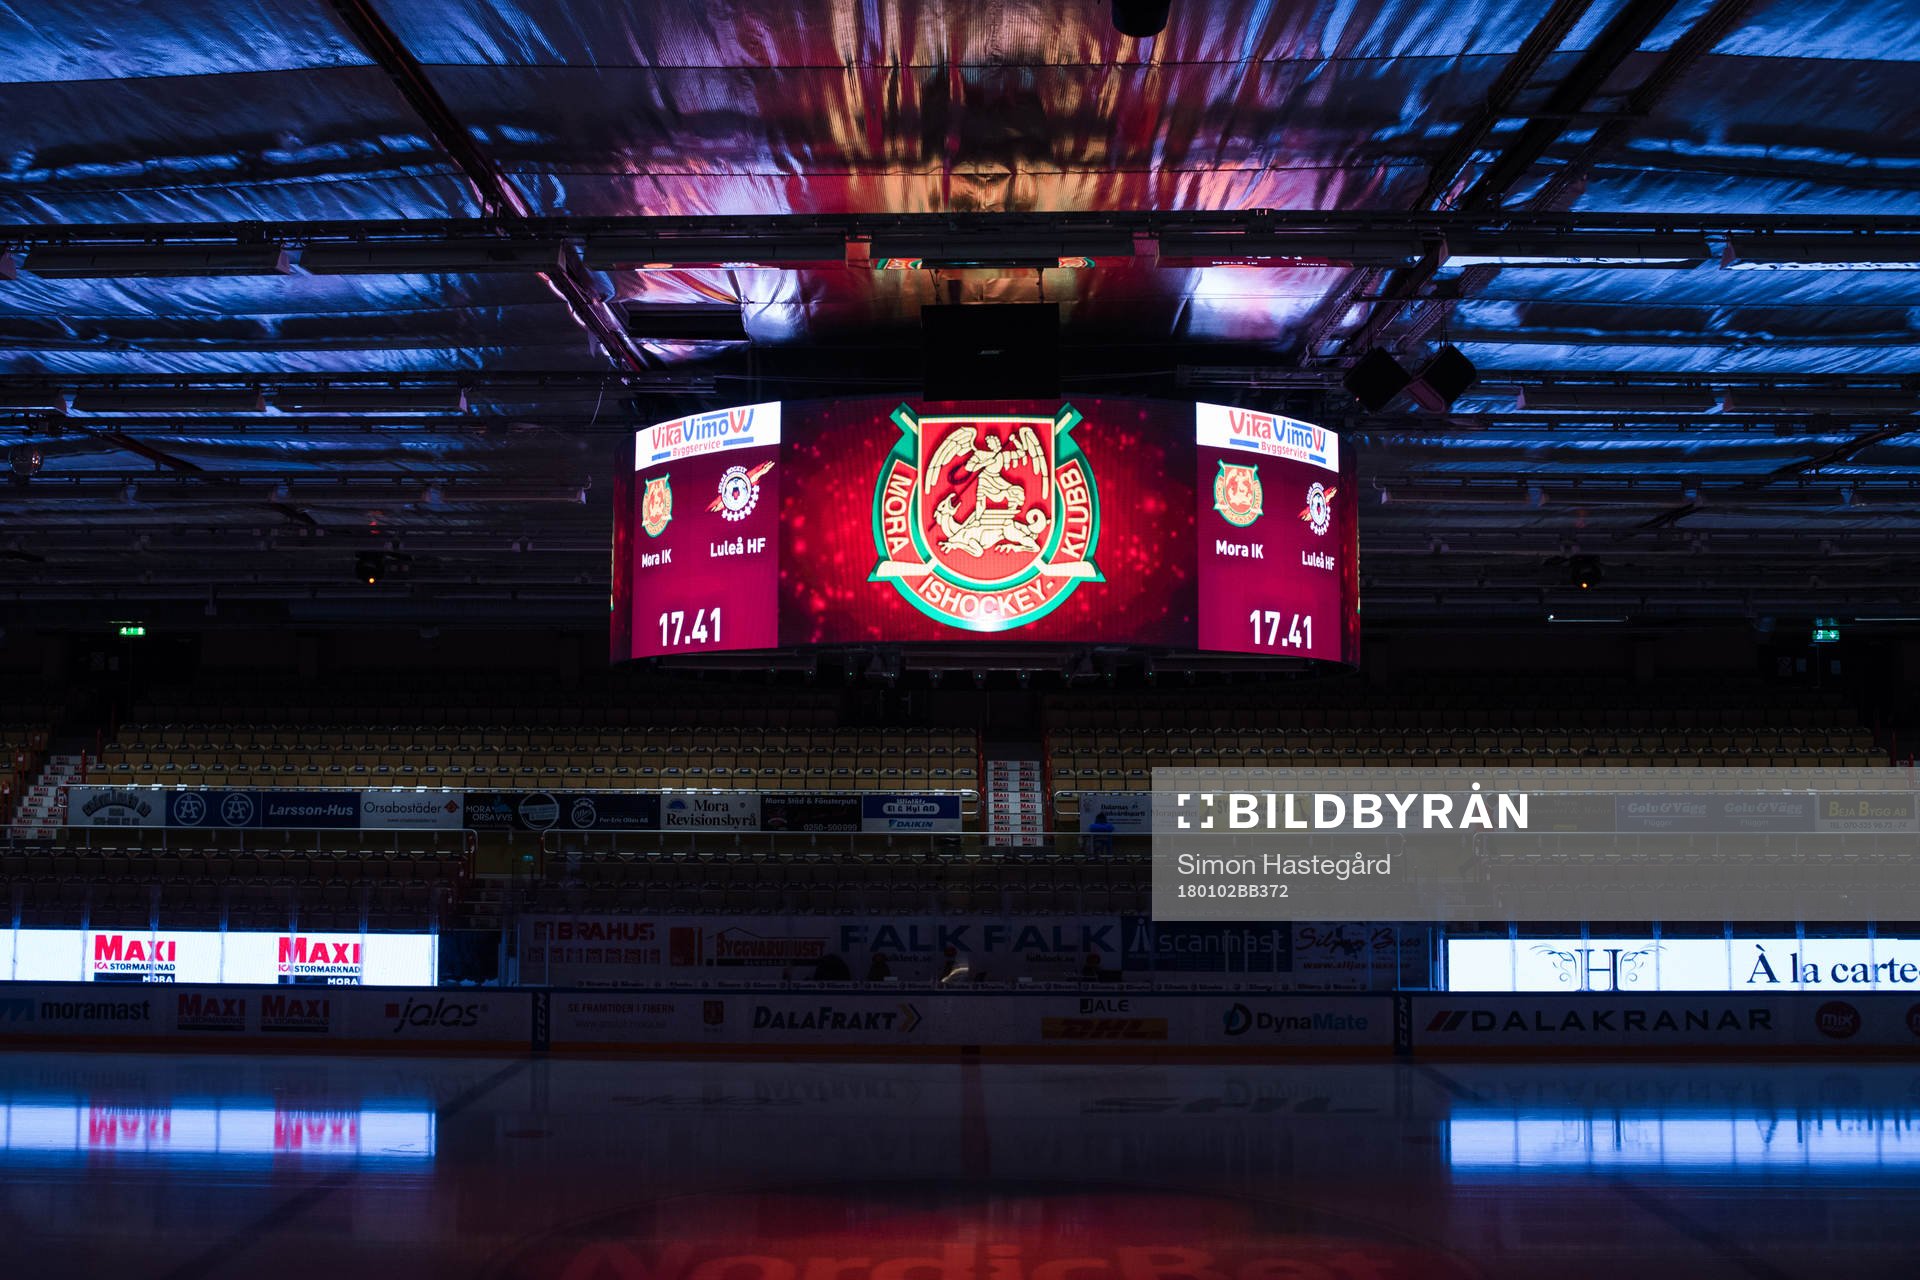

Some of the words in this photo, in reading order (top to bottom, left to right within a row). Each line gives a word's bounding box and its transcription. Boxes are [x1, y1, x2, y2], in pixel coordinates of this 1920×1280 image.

[672, 440, 721, 457] Byggservice
[1261, 441, 1308, 460] Byggservice
[710, 537, 744, 558] Luleå
[747, 537, 766, 554] HF
[884, 469, 913, 555] MORA
[917, 575, 1048, 618] ISHOCKEY
[1060, 467, 1090, 559] KLUBB
[1216, 540, 1249, 558] Mora
[1251, 544, 1264, 559] IK
[641, 552, 660, 568] Mora
[661, 548, 672, 564] IK
[1302, 551, 1323, 570] Luleå
[1324, 557, 1335, 571] HF
[659, 607, 721, 647] 17.41
[1249, 610, 1313, 650] 17.41
[269, 804, 354, 816] Larsson-Hus
[364, 800, 441, 814] Orsabostäder
[465, 805, 491, 813] MORA
[694, 800, 729, 812] Mora
[1829, 801, 1856, 816] BEJA
[1858, 801, 1892, 816] BYGG
[1893, 807, 1907, 816] AB
[666, 811, 756, 829] Revisionsbyrå
[896, 820, 933, 828] DAIKIN
[558, 922, 655, 940] BRAHUS
[841, 925, 971, 951] FALK
[984, 925, 1115, 951] FALK
[94, 935, 176, 961] MAXI
[278, 937, 360, 963] MAXI
[1159, 930, 1285, 953] scanmast
[94, 962, 108, 970] ICA
[110, 963, 175, 971] STORMARKNAD
[278, 964, 293, 972] ICA
[294, 965, 361, 973] STORMARKNAD
[1747, 944, 1780, 983] À
[1790, 953, 1822, 983] la
[1831, 957, 1920, 983] carte
[142, 975, 174, 983] MORA
[327, 977, 358, 985] MORA
[41, 1001, 150, 1021] moramast
[178, 993, 246, 1016] MAXI
[262, 995, 329, 1017] MAXI
[394, 998, 478, 1032] jalas
[753, 1005, 897, 1030] DALAFRAKT
[1256, 1011, 1368, 1035] DynaMate
[1472, 1009, 1772, 1031] DALAKRANAR
[1059, 1019, 1149, 1038] DHL
